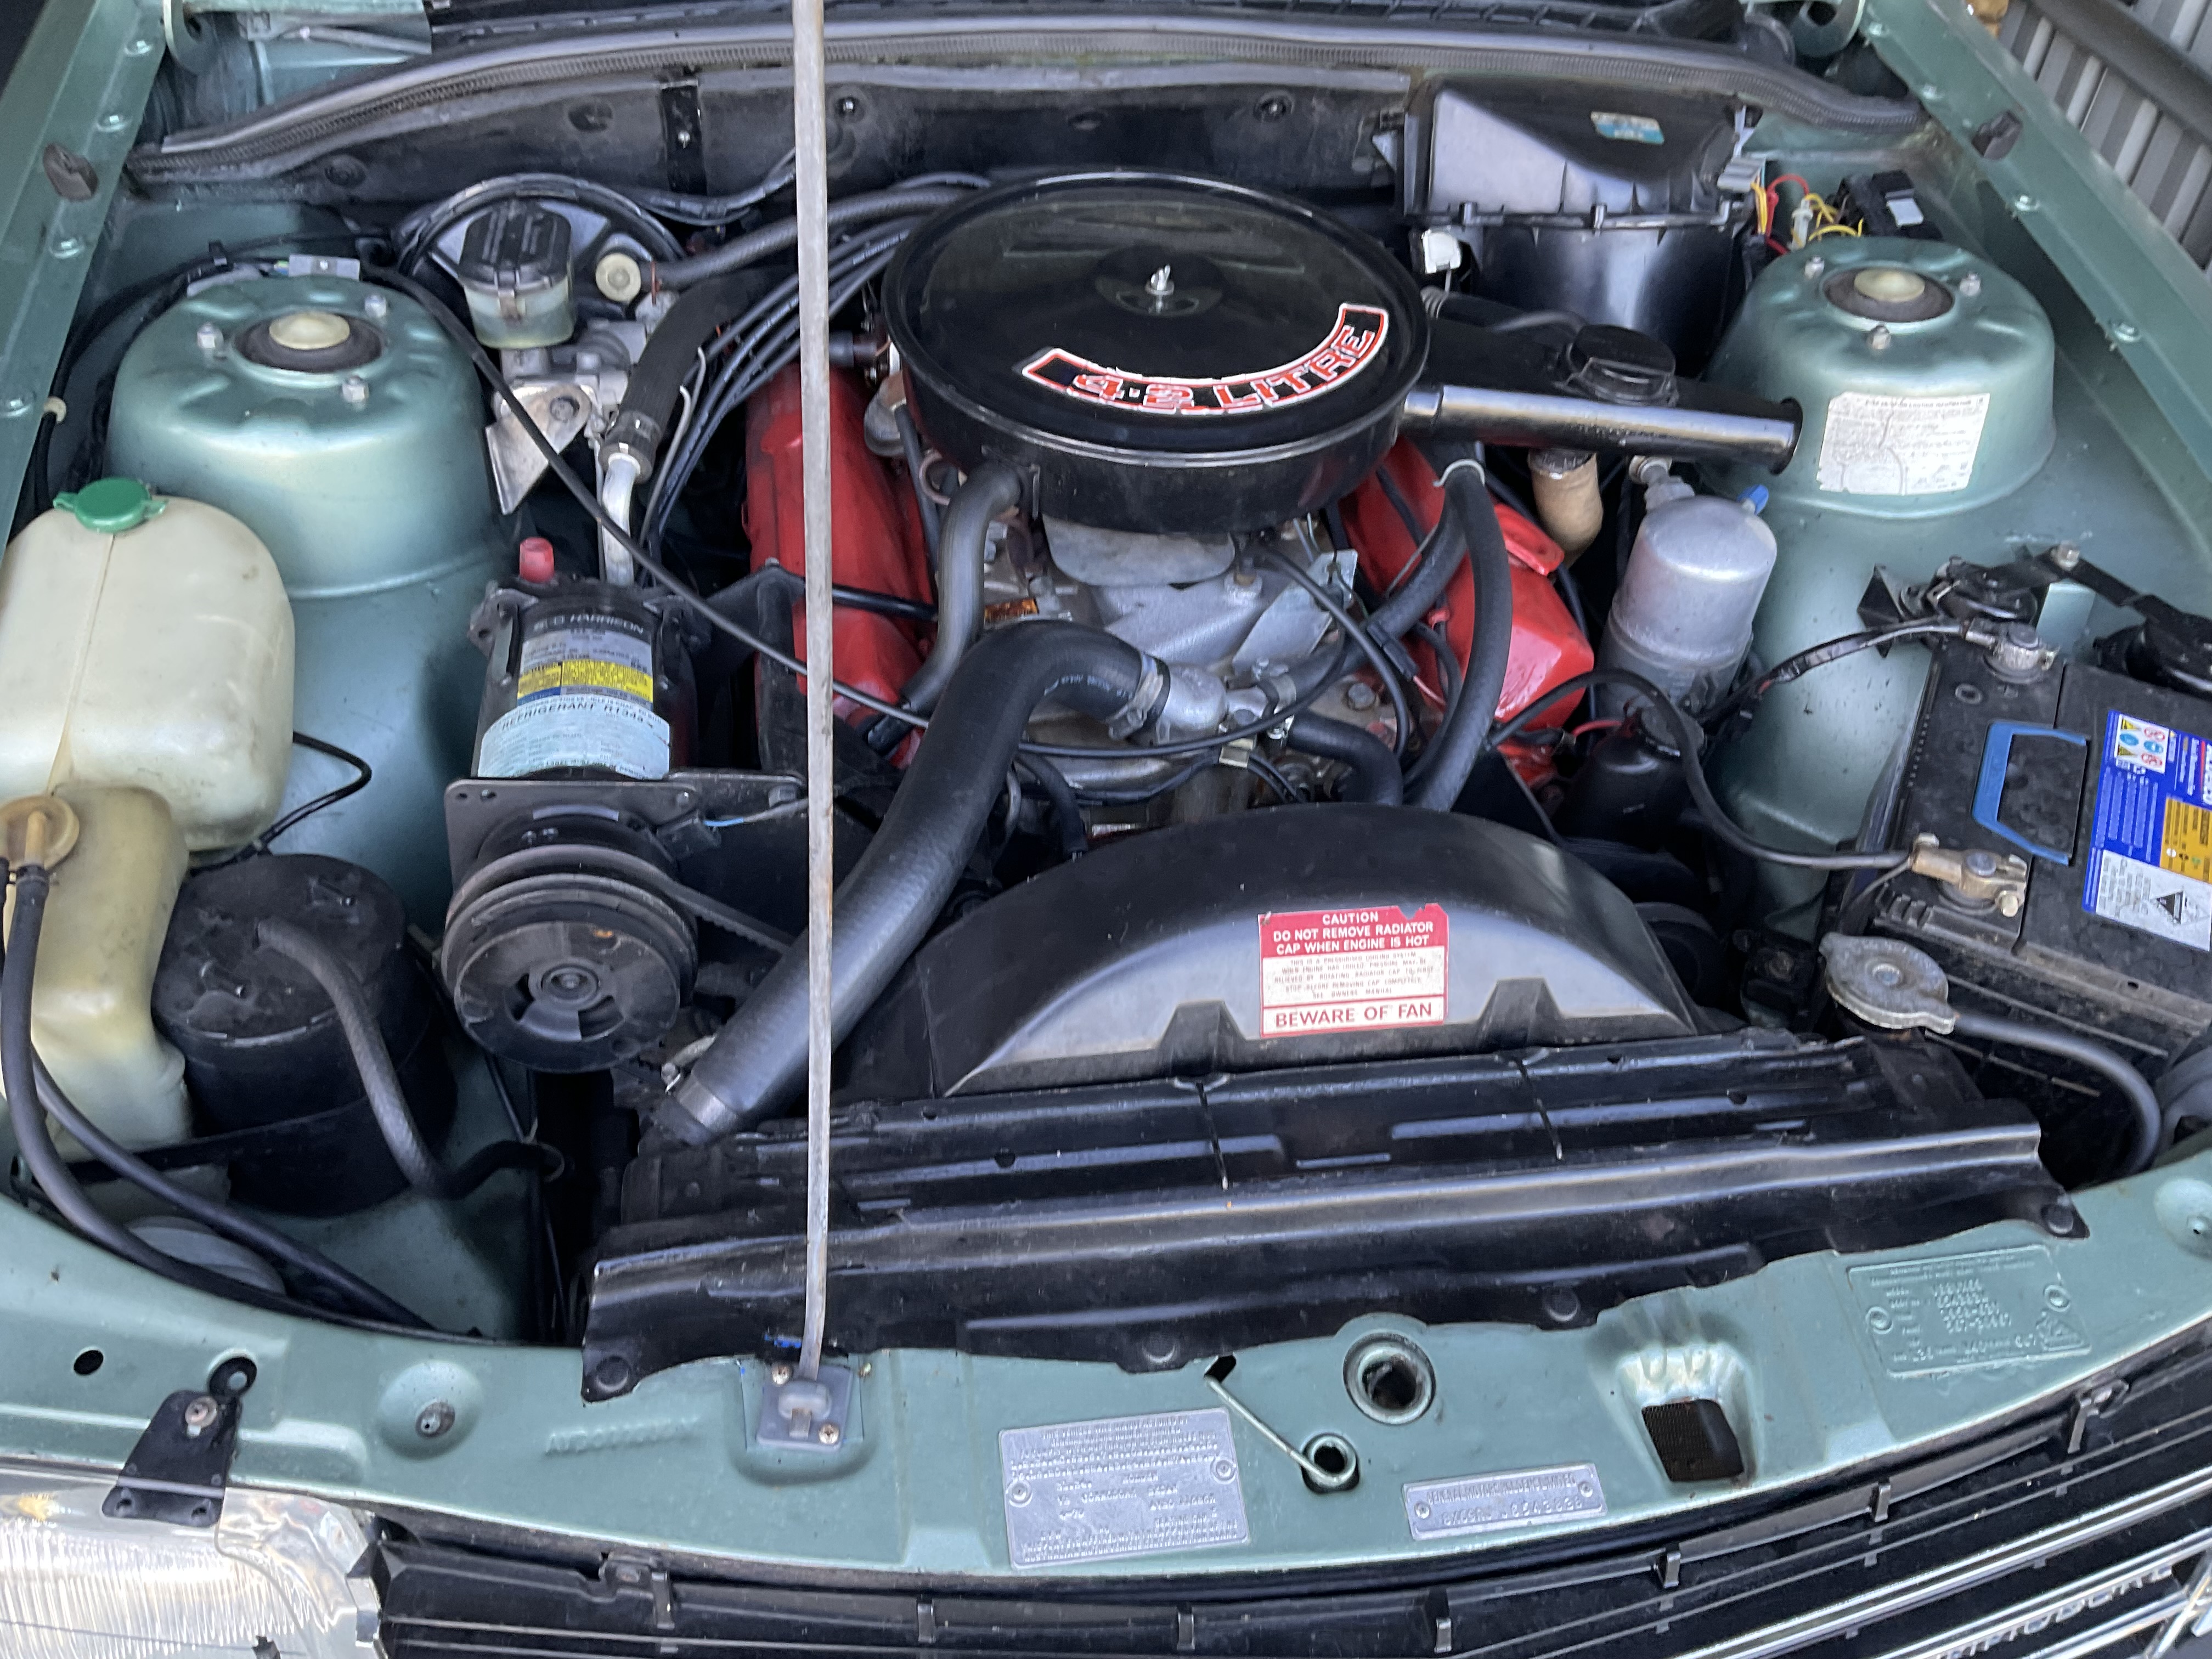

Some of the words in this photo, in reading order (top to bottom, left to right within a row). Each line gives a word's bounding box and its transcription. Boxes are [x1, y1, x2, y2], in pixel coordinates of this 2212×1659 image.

[1212, 324, 1375, 408] LITRE
[1322, 911, 1379, 926] CAUTION
[1273, 930, 1291, 943] DO
[1295, 928, 1319, 941] NOT
[1323, 925, 1370, 939] REMOVE
[1375, 921, 1433, 936] RADIATOR
[1277, 943, 1300, 955] CAP
[1305, 940, 1340, 953] WHEN
[1344, 938, 1385, 951] ENGINE
[1390, 936, 1401, 948] IS
[1406, 935, 1430, 946] HOT
[1276, 1007, 1355, 1028] BEWARE
[1364, 1005, 1389, 1020] OF
[1398, 1002, 1431, 1019] FAN
